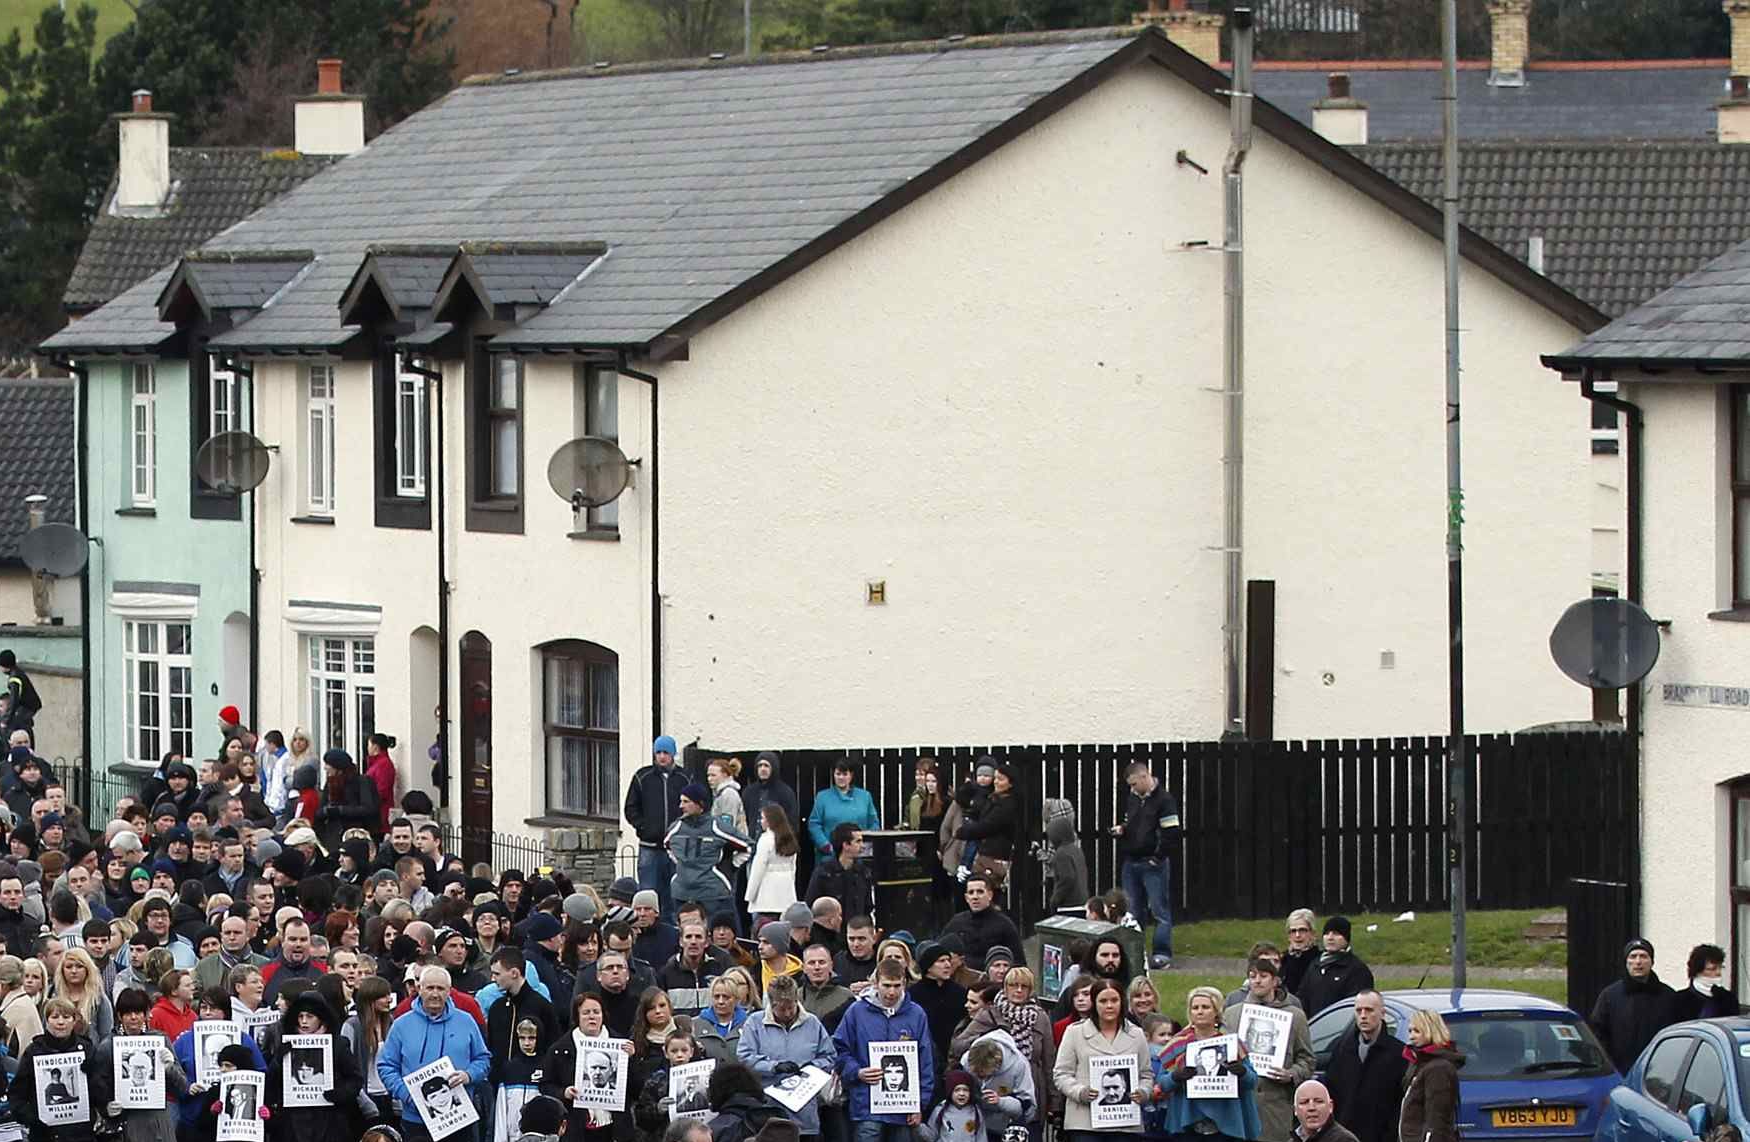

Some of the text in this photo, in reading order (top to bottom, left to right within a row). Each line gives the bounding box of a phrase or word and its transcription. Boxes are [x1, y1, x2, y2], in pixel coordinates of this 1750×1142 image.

[196, 1025, 238, 1033] VINDICATED
[116, 1040, 161, 1048] VINDICATED
[580, 1040, 620, 1050] VINDICATE
[872, 1045, 916, 1053] VINDICATED
[36, 1056, 82, 1066] VINDICATED
[1092, 1058, 1135, 1067] VINDICATED
[407, 1061, 449, 1085] VINDICATED
[223, 1074, 262, 1083] VINDICATED
[579, 1096, 617, 1104] CAMPBELL
